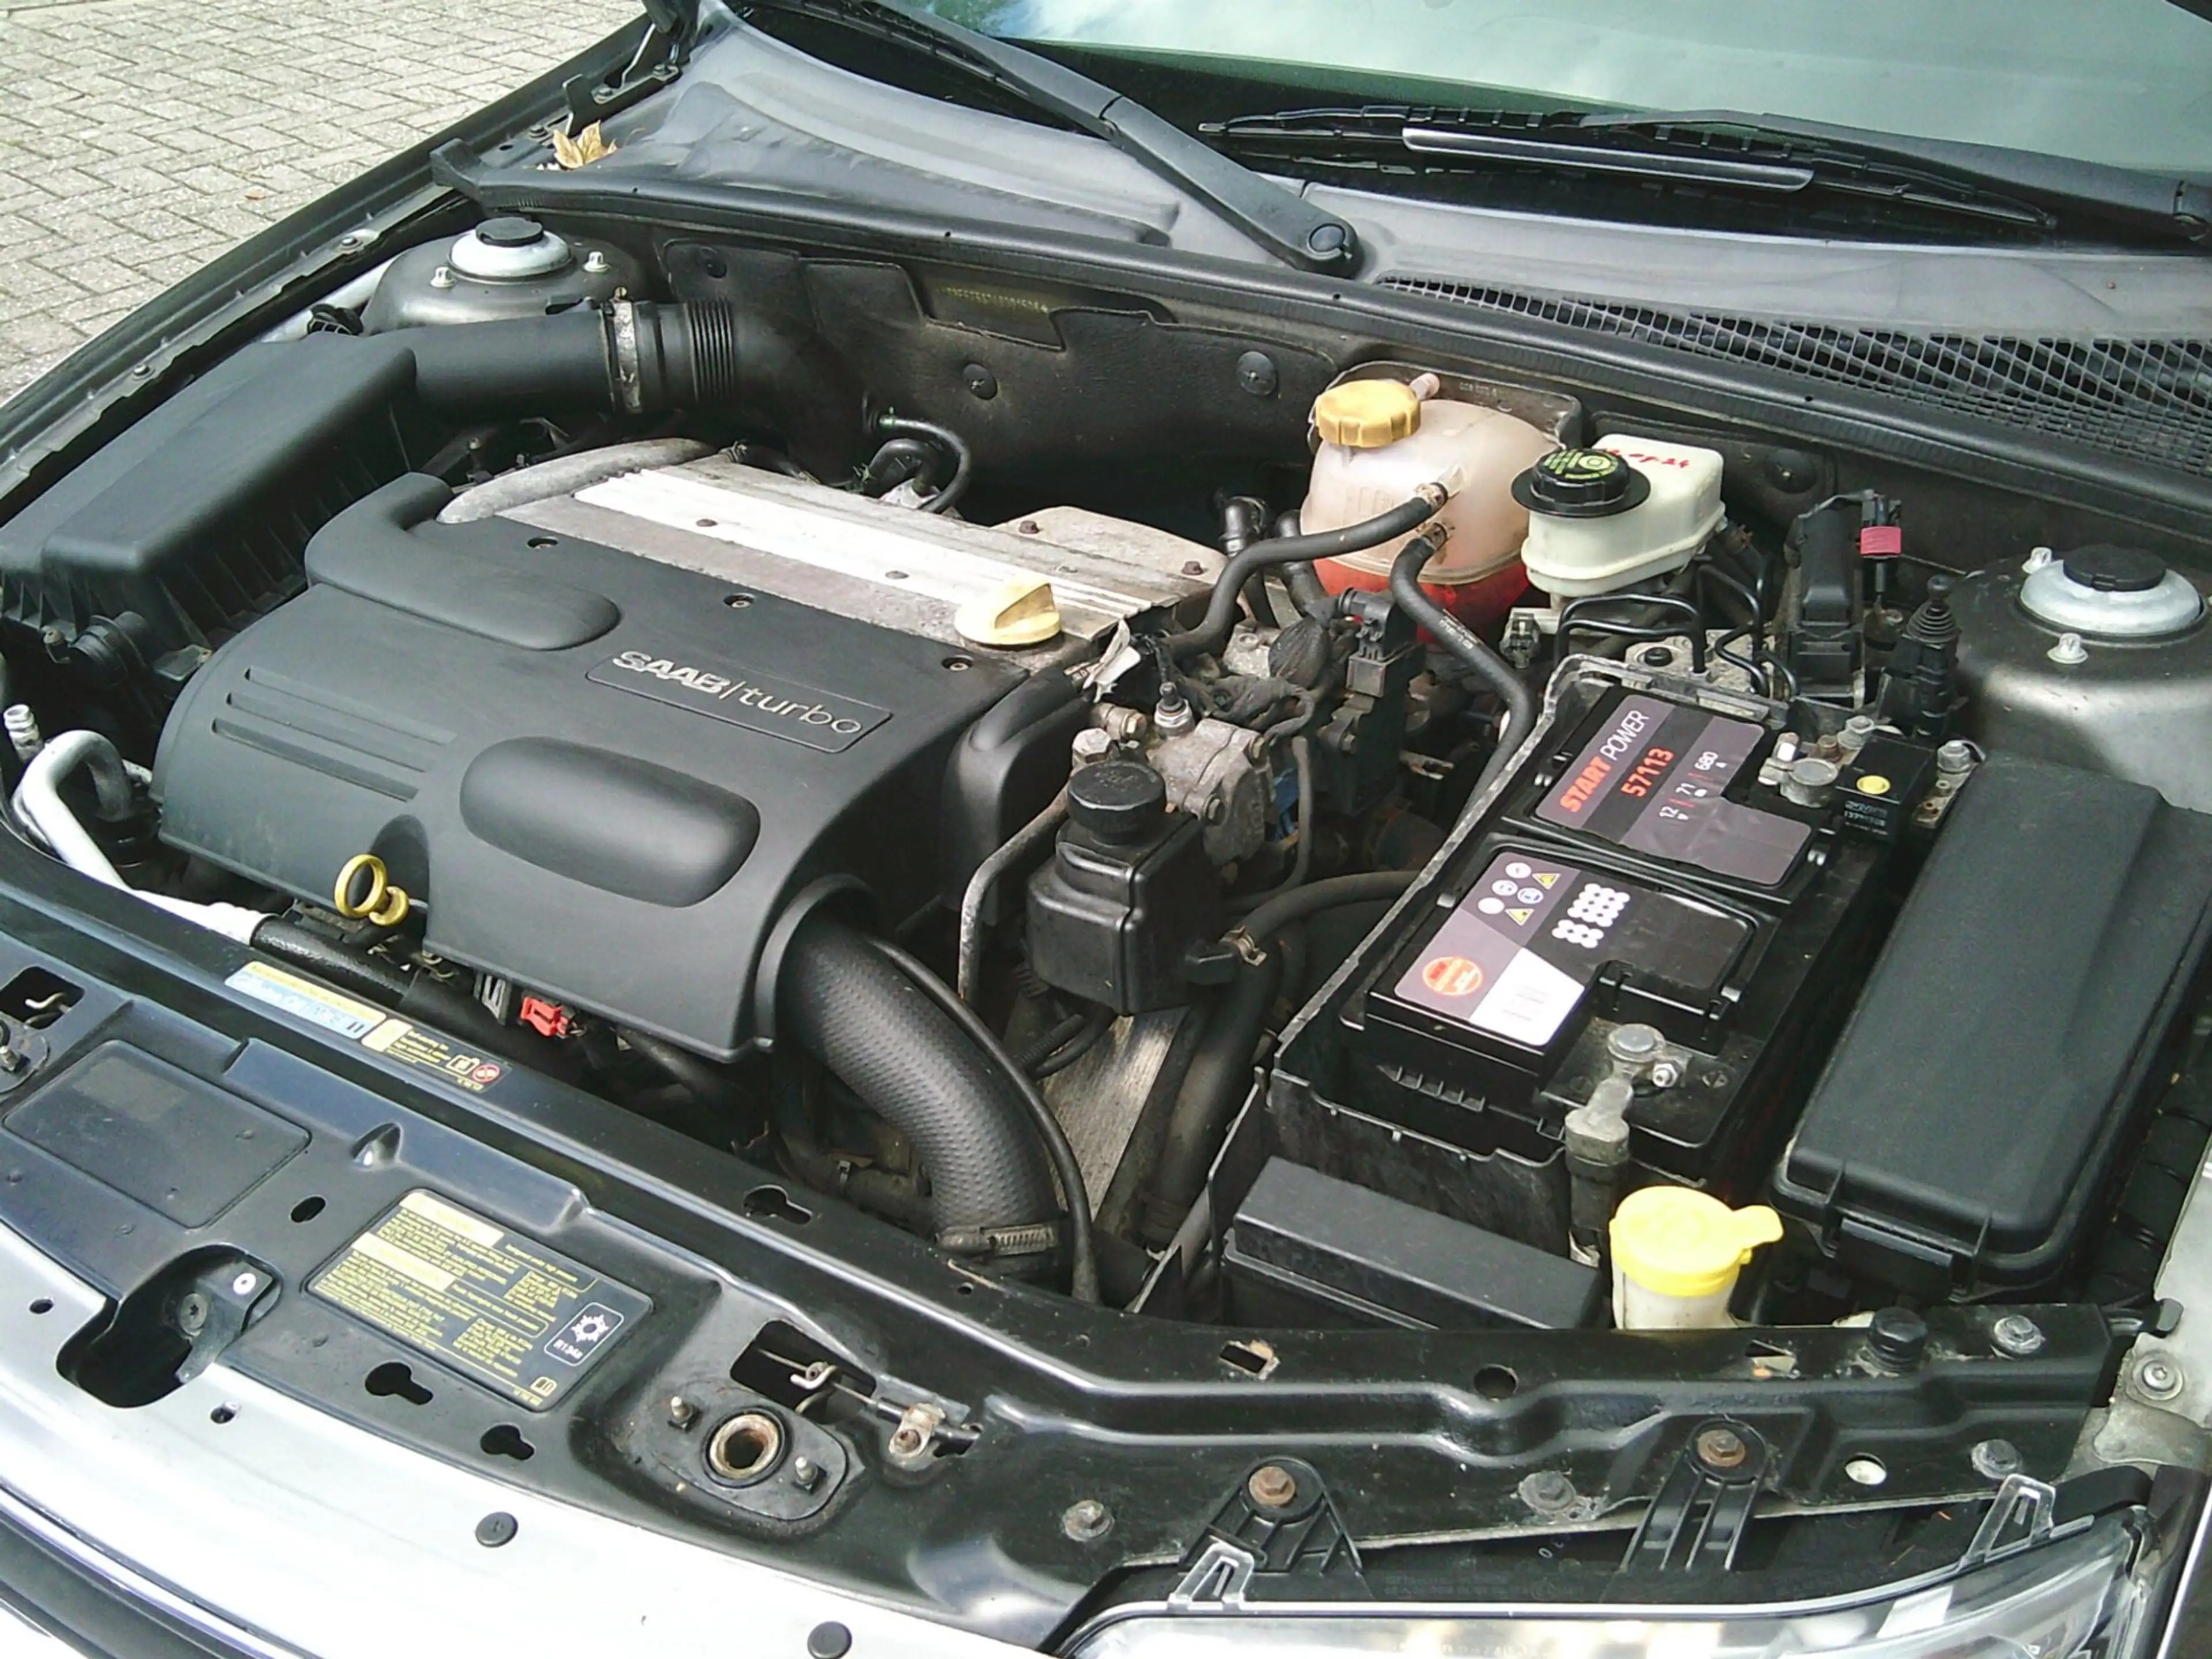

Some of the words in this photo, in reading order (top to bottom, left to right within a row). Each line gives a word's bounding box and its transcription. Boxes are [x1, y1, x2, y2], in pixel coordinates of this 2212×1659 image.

[1559, 756, 1611, 813] START
[1600, 709, 1650, 761] POWER
[1620, 746, 1675, 798] 57113
[1659, 806, 1679, 818] 12
[1675, 783, 1696, 796] 71
